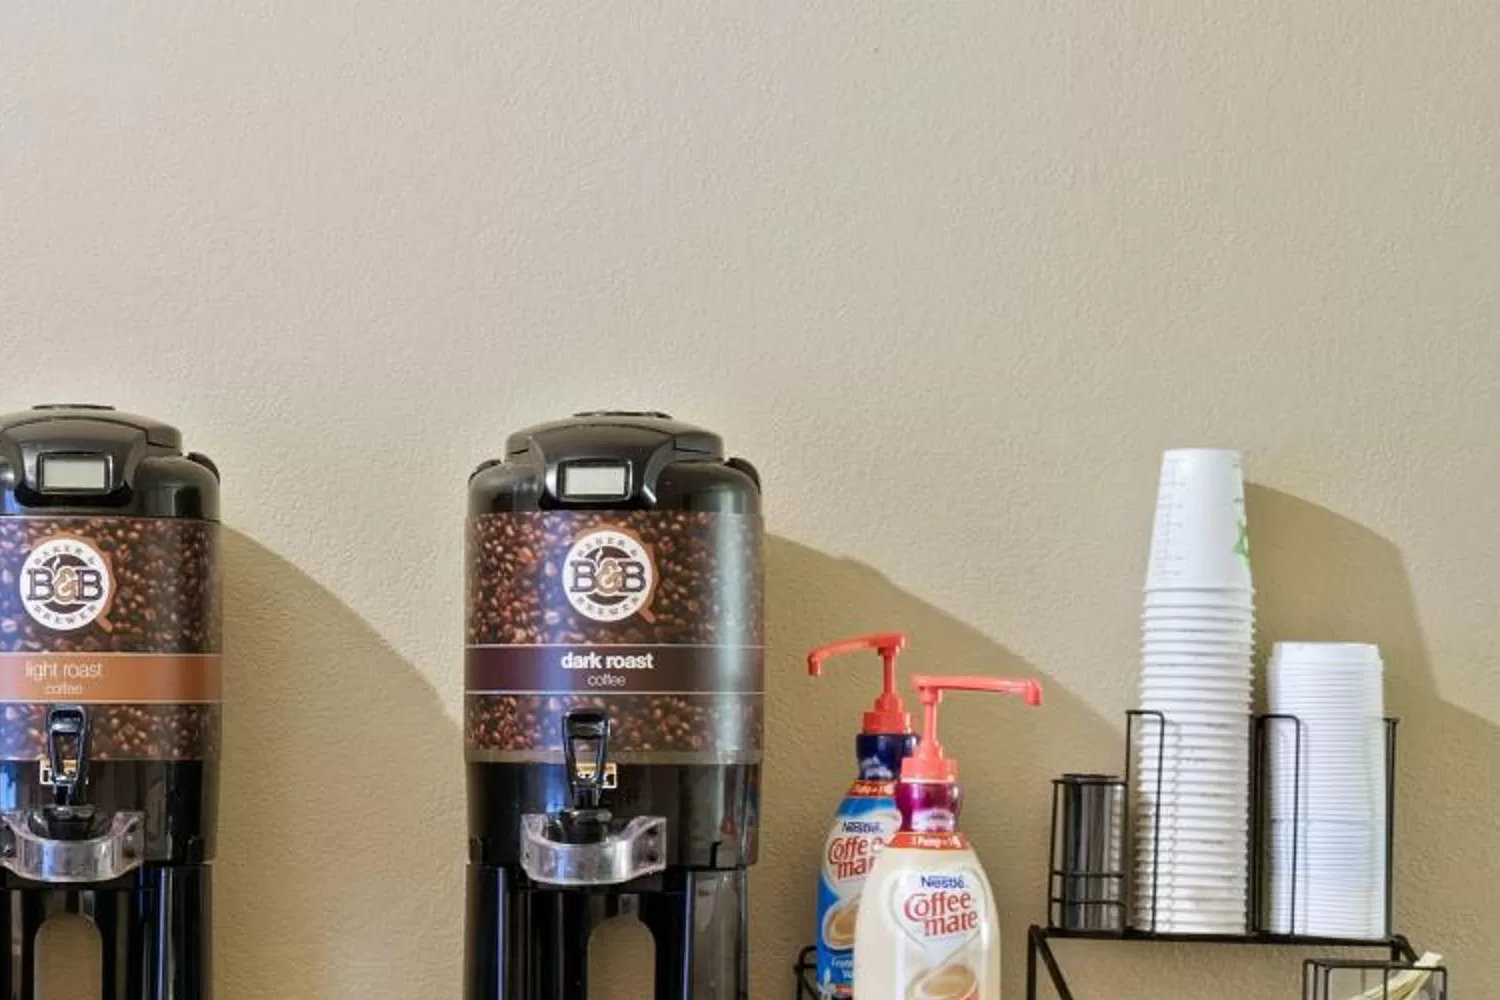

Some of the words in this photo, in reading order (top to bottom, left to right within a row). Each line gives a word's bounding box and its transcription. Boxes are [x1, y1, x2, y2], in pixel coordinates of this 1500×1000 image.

[27, 567, 103, 602] B&B
[570, 558, 647, 594] B&B
[26, 660, 58, 681] light
[63, 662, 103, 677] roast
[561, 651, 602, 669] dark
[605, 652, 654, 669] roast
[587, 673, 626, 686] coffee
[903, 890, 971, 922] Coffee
[924, 911, 978, 937] mate
